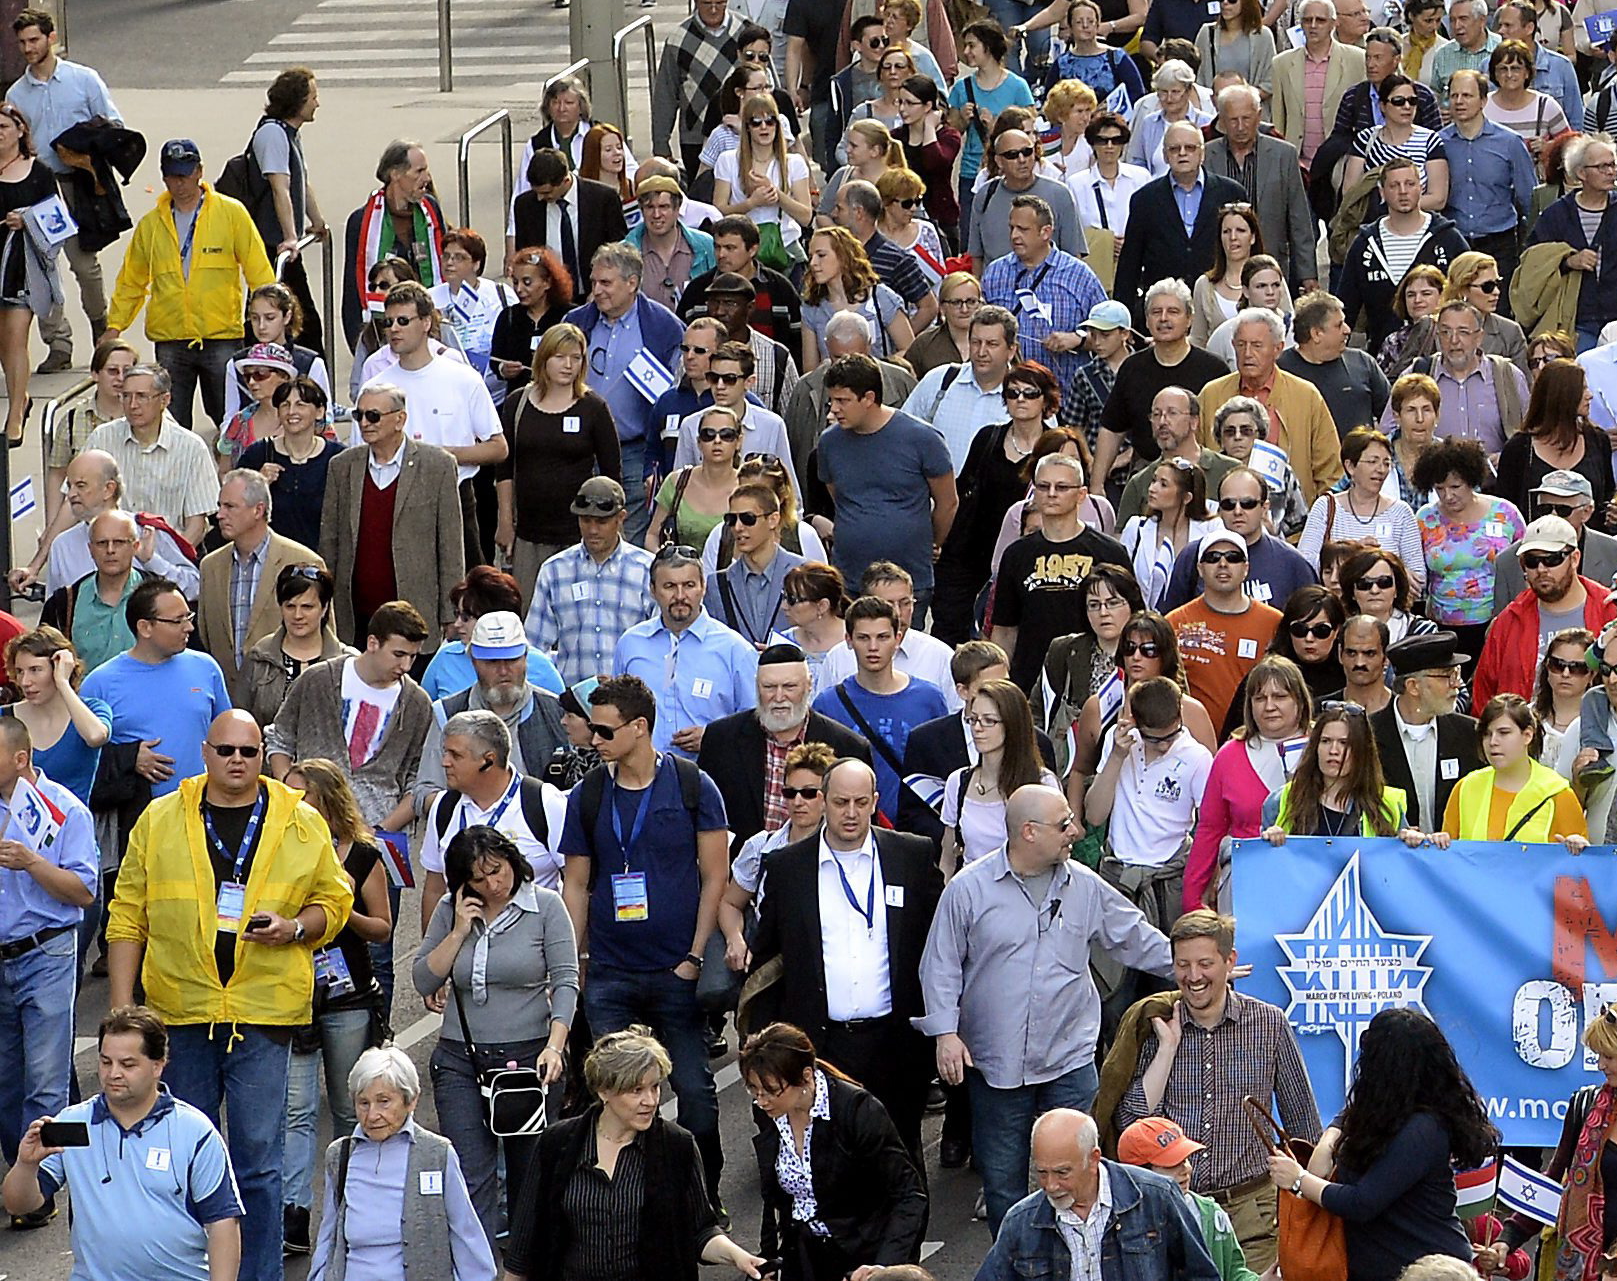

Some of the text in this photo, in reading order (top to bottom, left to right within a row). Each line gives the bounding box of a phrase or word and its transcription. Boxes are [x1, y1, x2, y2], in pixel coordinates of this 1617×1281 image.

[1034, 553, 1094, 580] 1957
[1305, 992, 1328, 1001] MARCH
[1329, 992, 1338, 1001] OF
[1339, 992, 1350, 1000] THE
[1351, 992, 1373, 1000] LIVING
[1377, 990, 1403, 1000] POLAND
